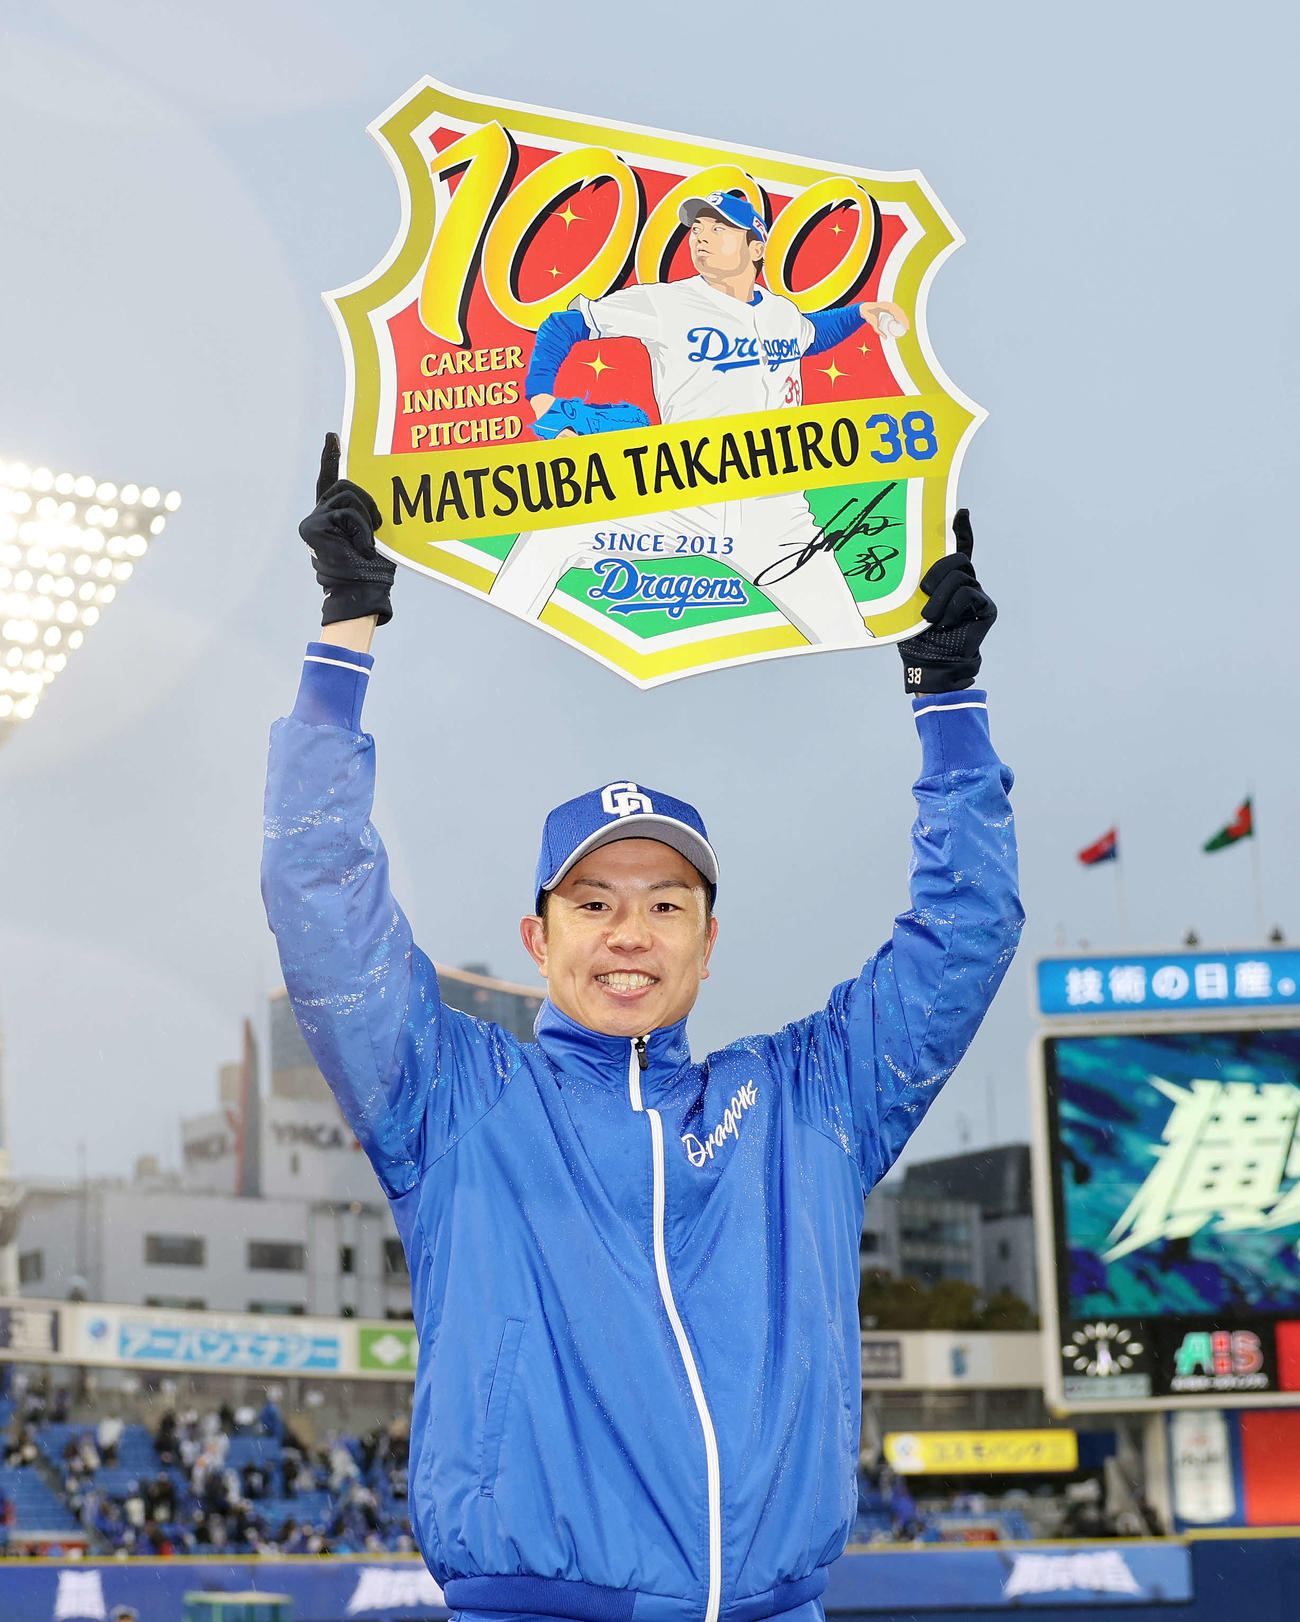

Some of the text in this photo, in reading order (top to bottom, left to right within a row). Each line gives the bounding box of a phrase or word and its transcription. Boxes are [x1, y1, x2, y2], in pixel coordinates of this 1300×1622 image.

[417, 119, 881, 349] 1000
[420, 346, 525, 377] CAREER
[402, 381, 520, 414] INNINGS
[411, 416, 522, 448] PITCHED
[391, 411, 937, 525] MATSUBA TAKAHIRO 38
[592, 532, 734, 554] SINCE 2013
[843, 545, 899, 582] 38
[588, 557, 749, 619] Dragons
[907, 667, 922, 684] 38
[681, 1079, 758, 1168] Dragons
[1101, 1074, 1300, 1264] 横
